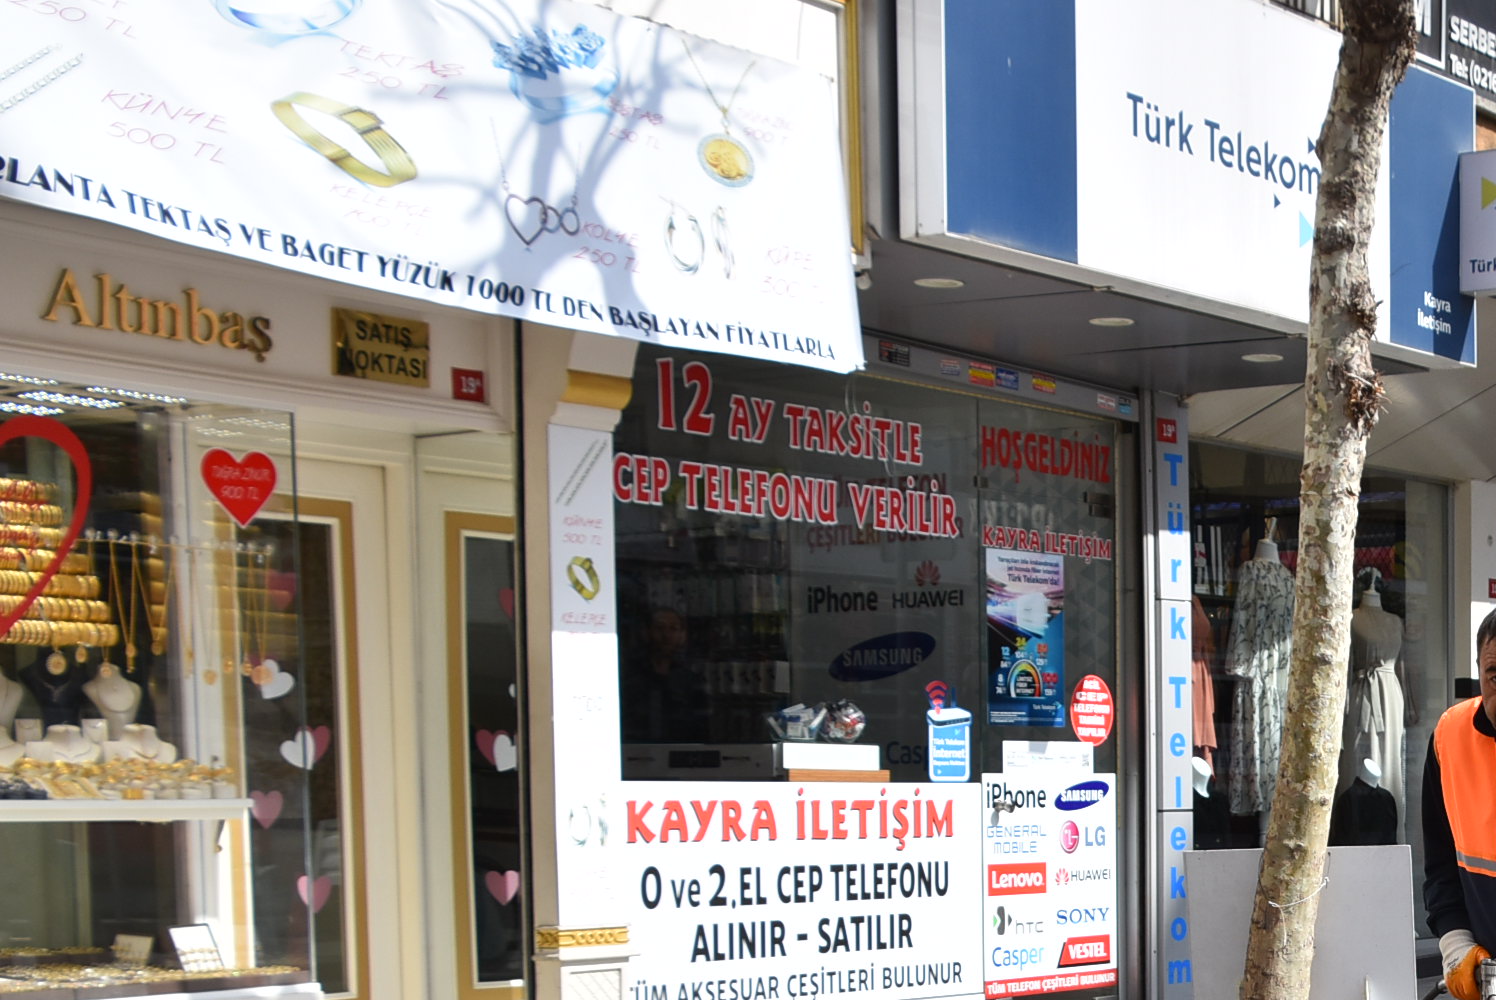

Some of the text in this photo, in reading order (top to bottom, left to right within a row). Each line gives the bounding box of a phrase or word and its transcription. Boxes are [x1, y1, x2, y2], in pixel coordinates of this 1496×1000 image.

[107, 121, 225, 165] 500 TL
[1126, 91, 1322, 195] Türk Telekom
[121, 189, 233, 246] TEKTAŞ
[239, 222, 273, 252] VE
[281, 234, 370, 273] BAGET
[377, 253, 455, 292] YÜZÜK
[467, 274, 525, 307] 1000
[530, 288, 556, 313] TL
[562, 296, 604, 322] DEN
[608, 305, 720, 340] BAŞLAYAN
[726, 320, 836, 361] FİYATLARLA
[43, 267, 272, 363] Altınbaş
[1424, 291, 1451, 313] Kayra
[1417, 308, 1451, 335] İletişim
[355, 319, 412, 352] SATIŞ
[656, 357, 923, 466] 12 AY TAKSİTLE
[981, 425, 1111, 484] HOŞGELDİNİZ
[612, 451, 671, 507] CEP
[679, 460, 838, 526] TELEFONU
[847, 474, 959, 539] VERİLİR
[982, 524, 1041, 552] KAYRA
[1045, 525, 1112, 565] İLETİŞİM
[807, 586, 879, 614] iPhone
[892, 589, 964, 609] HUAWEI
[842, 647, 923, 667] SAMSUNG
[1075, 691, 1109, 703] CEP
[986, 782, 1047, 809] iPhone
[1060, 788, 1105, 802] SAMSUNG
[626, 787, 954, 852] KAYRA İLETİŞİM
[986, 825, 1047, 838] GENERAL
[994, 841, 1037, 854] MOBILE
[1085, 825, 1106, 847] LG
[671, 877, 701, 908] ve
[777, 865, 823, 904] CEP
[830, 861, 949, 902] TELEFONU
[991, 871, 1044, 889] Lenovo
[1070, 868, 1111, 881] HUAWEI
[1056, 908, 1110, 925] SONY
[690, 919, 787, 963] ALINIR
[818, 913, 913, 954] SATILIR
[1068, 941, 1107, 960] VESTEL
[992, 946, 1045, 971] Casper
[882, 962, 963, 990] BULUNUR
[986, 982, 1005, 995] TÜM
[1007, 980, 1040, 993] TELEFON
